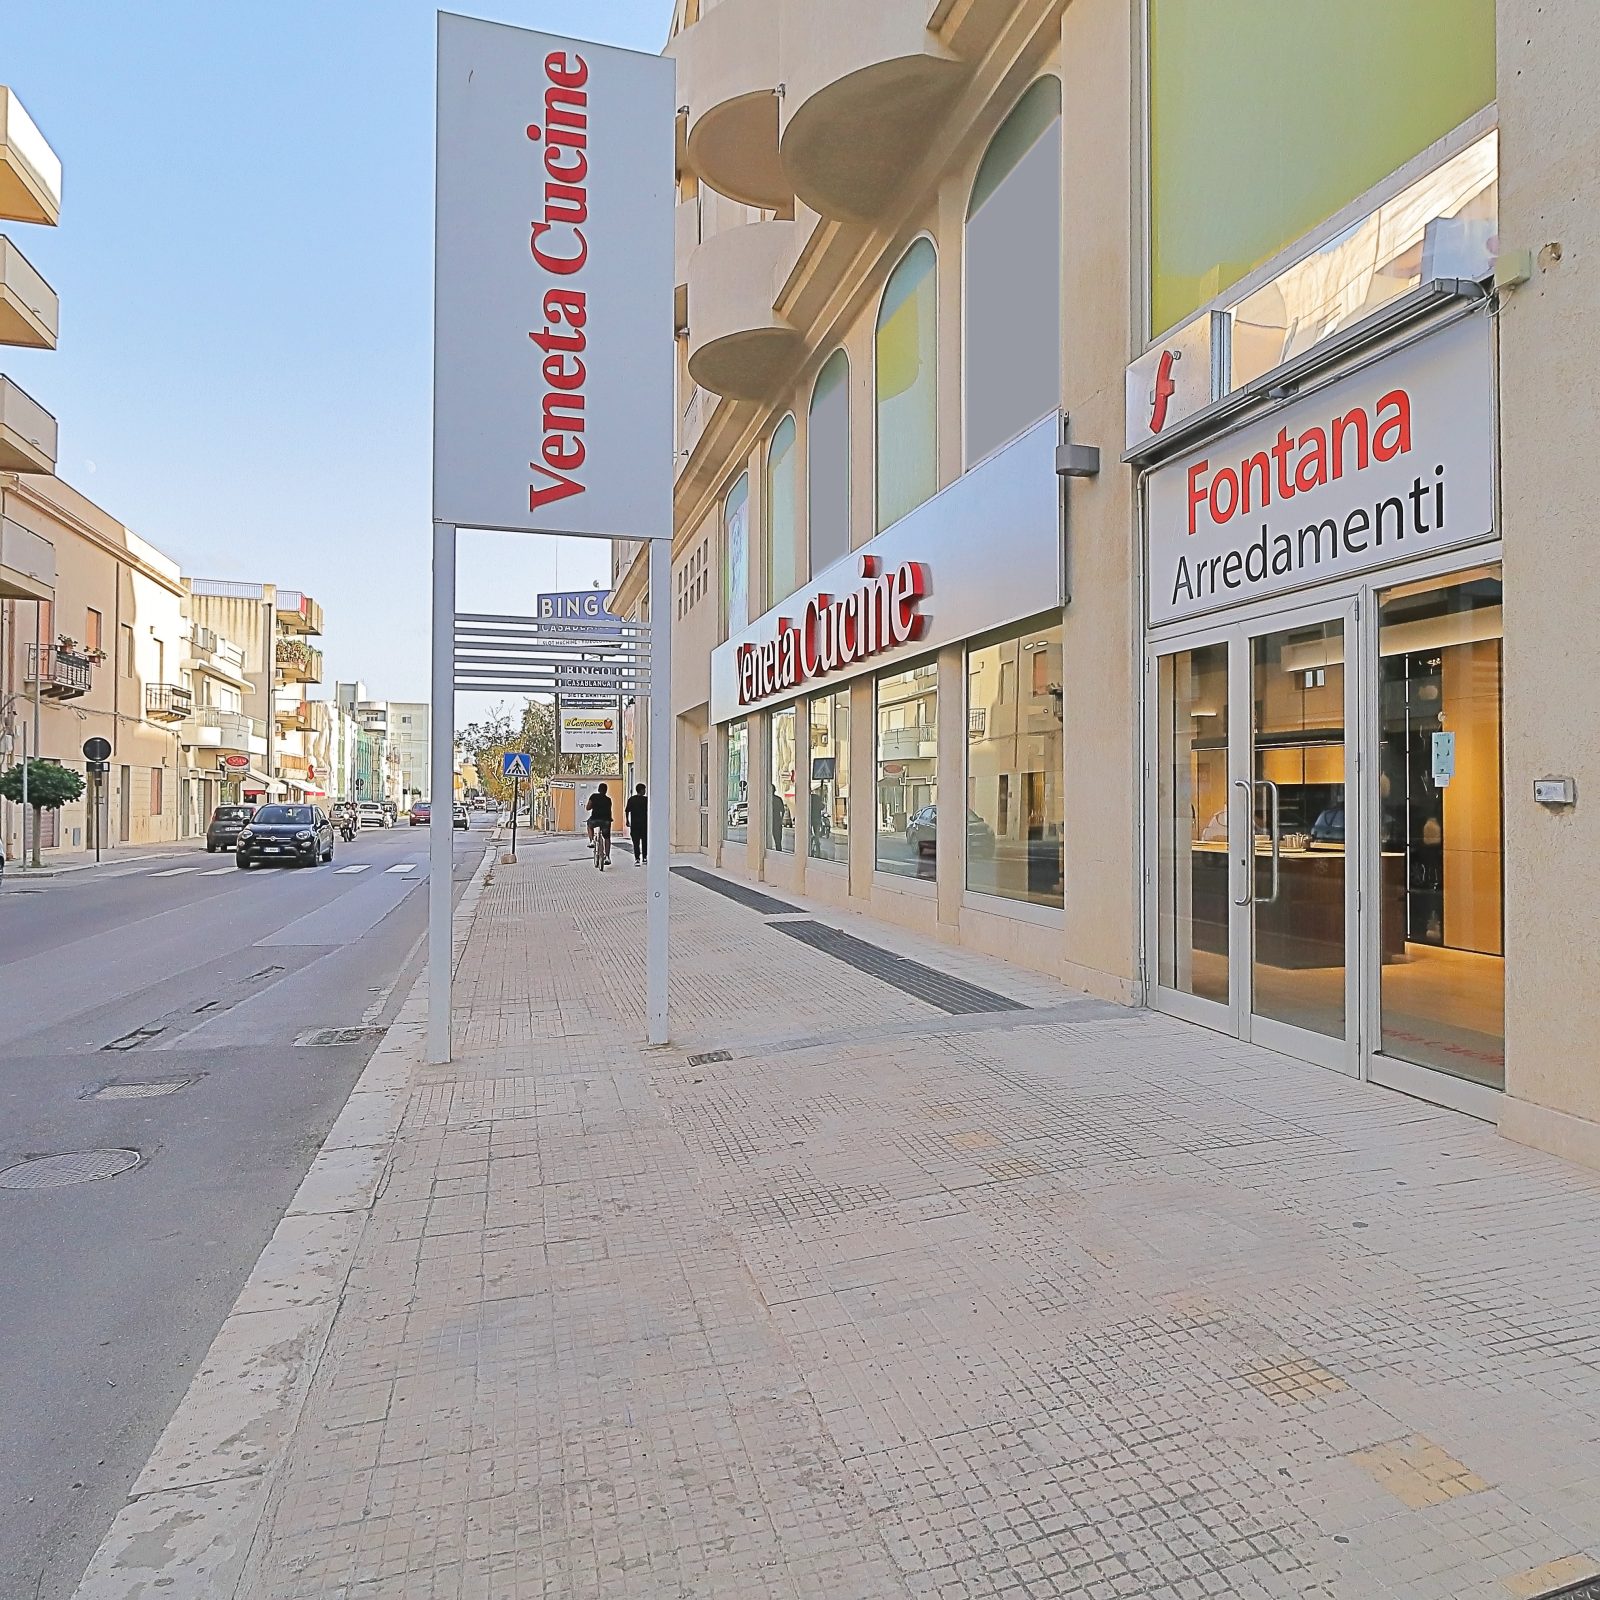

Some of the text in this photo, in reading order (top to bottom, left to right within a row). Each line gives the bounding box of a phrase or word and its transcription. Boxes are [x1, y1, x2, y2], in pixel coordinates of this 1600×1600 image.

[526, 51, 589, 512] Veneta Cucine
[1171, 464, 1445, 605] Arredamenti
[1187, 389, 1412, 536] Fontana
[567, 679, 611, 687] CASABLANCA
[735, 555, 926, 706] Veneta Cucine
[572, 717, 603, 727] Centesimo
